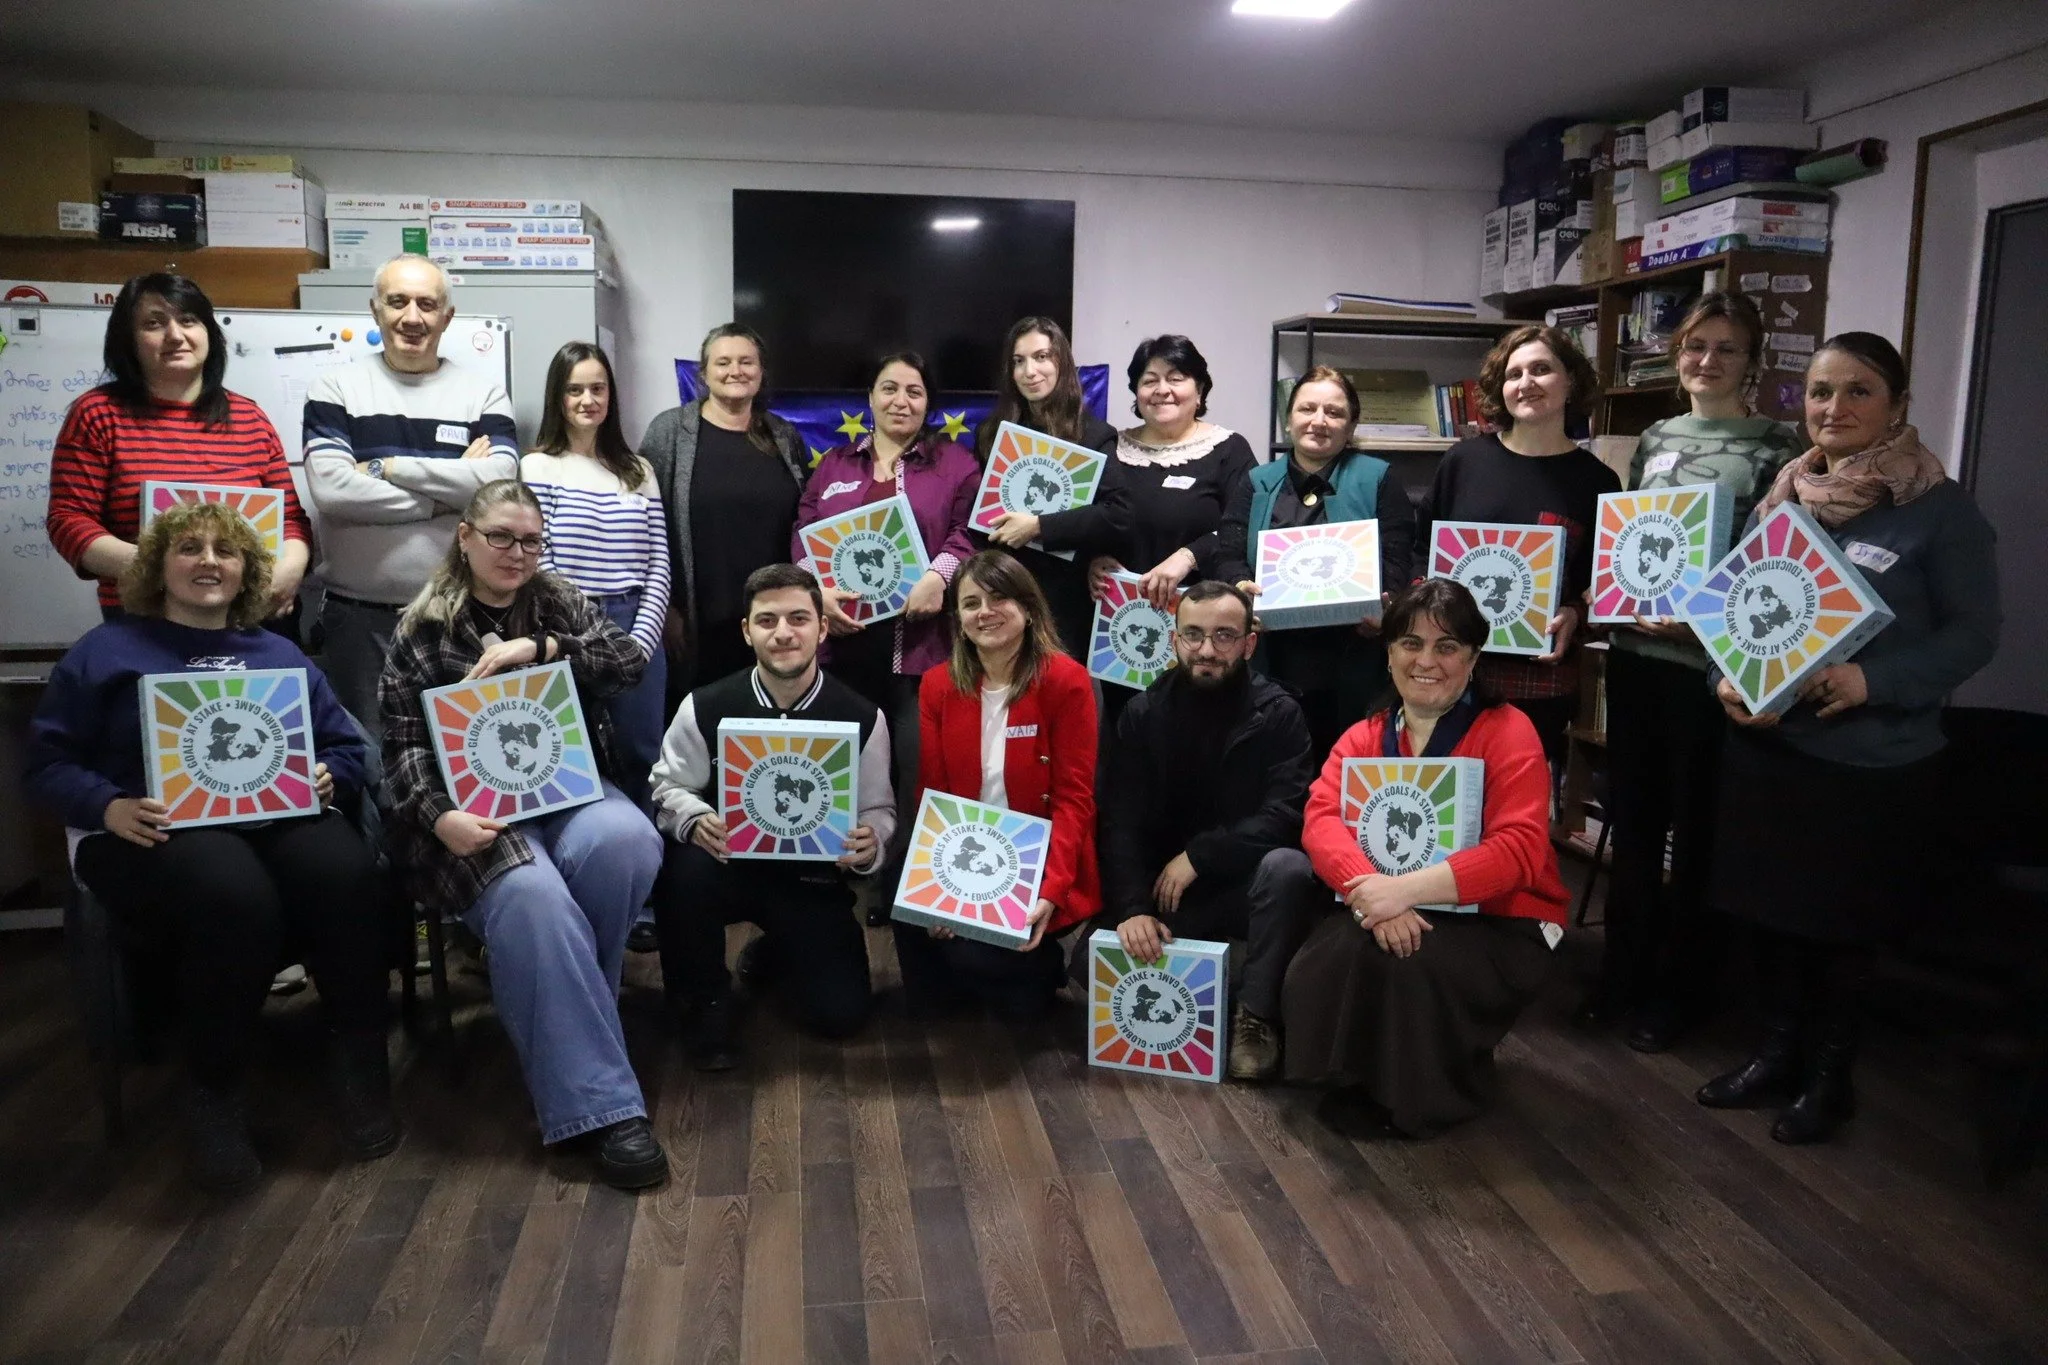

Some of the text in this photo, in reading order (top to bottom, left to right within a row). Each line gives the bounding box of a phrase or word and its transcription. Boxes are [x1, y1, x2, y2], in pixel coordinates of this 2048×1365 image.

[1559, 230, 1579, 238] deli
[1648, 251, 1678, 266] Double
[1008, 458, 1071, 496] GLOBAL GOALS AT STAKE
[1616, 514, 1687, 551] GLOBAL GOALS AT STAKE
[834, 545, 846, 571] GLOBAL
[845, 533, 866, 549] GOALS
[877, 536, 896, 557] STAKE
[1451, 547, 1491, 580] EDUCATIONA
[1500, 549, 1527, 572] GLOBAL
[880, 580, 898, 598] BOARD
[1521, 573, 1531, 601] GOALS
[1614, 558, 1687, 598] EDUCATIONAL BOARD GAME
[1515, 601, 1526, 613] AT
[1725, 560, 1803, 636] EDUCATIONAL BOARD GAME
[1111, 602, 1145, 668] EDUCATIONAL BOARD GAME
[1740, 581, 1816, 655] GLOBAL GOALS AT STAKE
[1144, 658, 1162, 669] STAKE
[1162, 652, 1169, 660] AT
[468, 701, 556, 748] GLOBAL GOALS AT STAKE
[183, 702, 230, 793] GLOBAL GOALS AT STAKE
[235, 700, 285, 793] EDUCATIONAL BOARD GAME
[471, 739, 561, 792] EDUCATIONAL BOARD GAME
[746, 756, 829, 791] GLOBAL GOALS AT STAKE
[744, 798, 830, 836] EDUCATIONAL BOARD GAME
[1363, 785, 1435, 826] GLOBAL GOALS AT STAKE
[934, 825, 977, 896] GLOBAL GOALS AT STAKE
[971, 827, 1017, 902] EDUCATIONAL BOARD GAME
[1422, 837, 1436, 862] GAME
[1113, 971, 1149, 1048] GLOBAL GOALS AT STAKE
[1157, 972, 1196, 1051] EDUCATIONAL BOARD GAME
